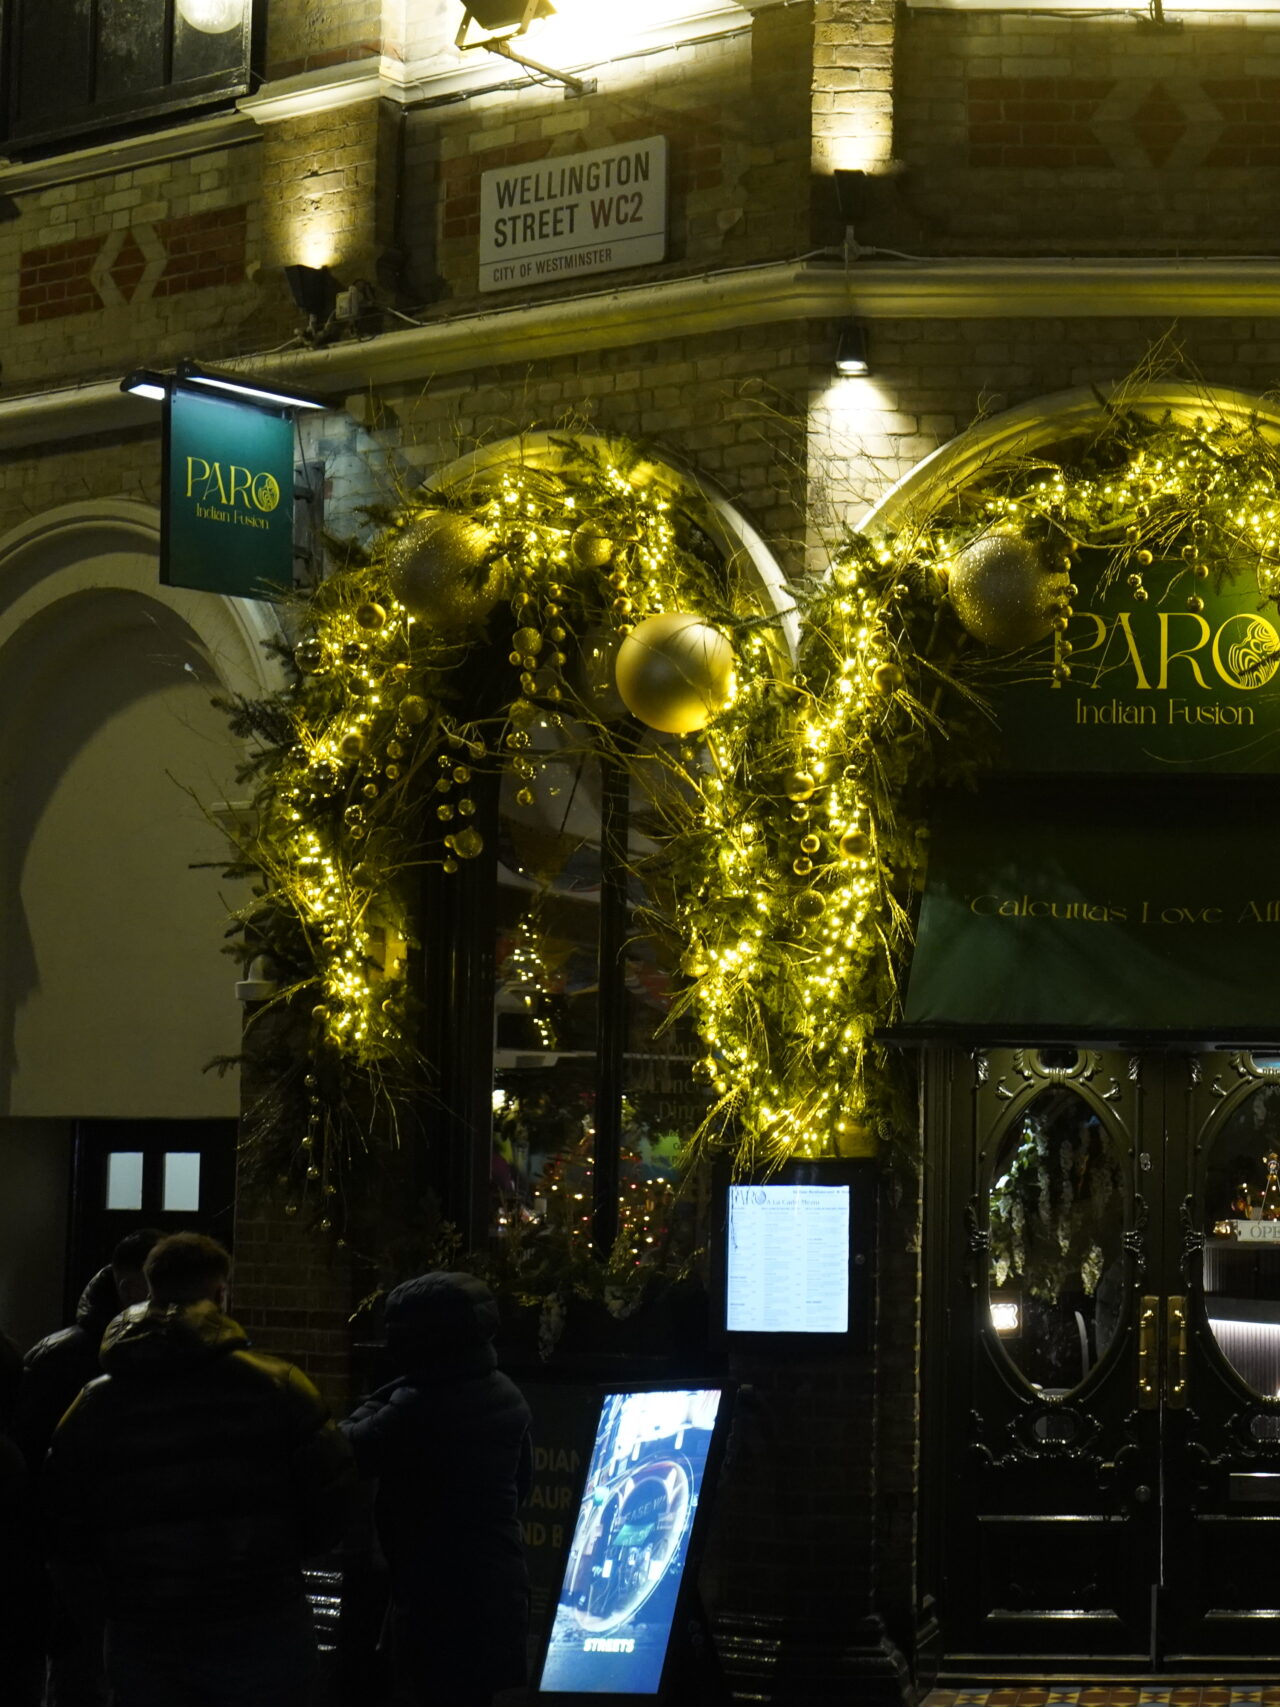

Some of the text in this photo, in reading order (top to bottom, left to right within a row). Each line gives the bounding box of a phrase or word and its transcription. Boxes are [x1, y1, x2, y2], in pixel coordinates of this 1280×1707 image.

[496, 151, 650, 209] WELLINGTON
[494, 192, 643, 248] STREET WC2
[493, 248, 612, 282] CITY OF WESTMINSTER
[186, 456, 280, 512] PARO
[195, 502, 270, 530] Indian Fusion
[1050, 612, 1280, 690] PARO
[1076, 698, 1255, 725] Indian Fusion
[1141, 901, 1225, 925] Love
